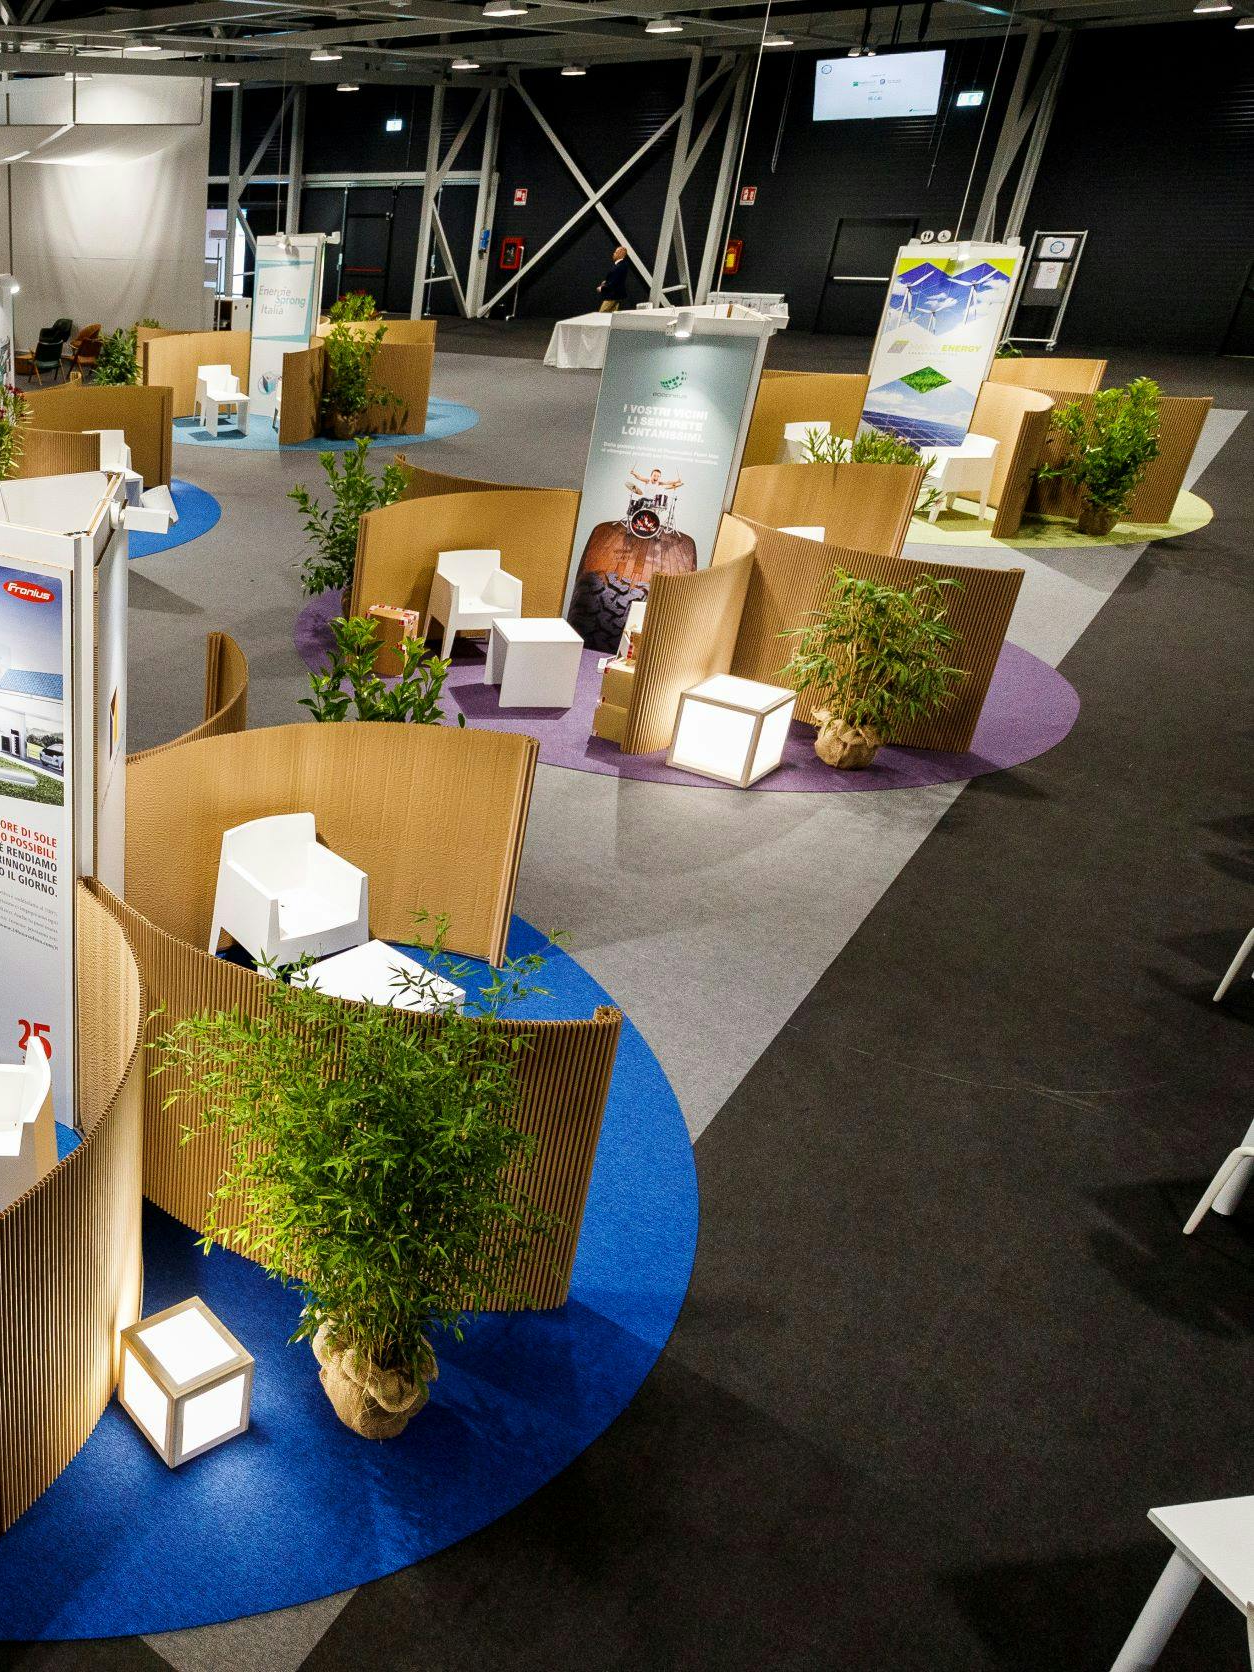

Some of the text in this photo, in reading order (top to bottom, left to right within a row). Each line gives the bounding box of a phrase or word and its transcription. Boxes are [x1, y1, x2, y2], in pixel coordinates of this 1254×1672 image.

[261, 303, 284, 315] Italia
[941, 344, 982, 352] ENERGY
[623, 403, 708, 420] I VOSTRI VICINI
[627, 415, 703, 432] LI SENTIRETE
[621, 426, 704, 443] LONTANISSIMI.
[7, 582, 51, 600] Fronius
[0, 819, 18, 834] ORE
[21, 827, 31, 838] DI
[34, 831, 57, 848] SOLE
[10, 836, 58, 860] POSSIBILI.
[7, 845, 57, 872] RENDIAMO
[8, 870, 16, 881] IL
[18, 875, 58, 898] GIORNO.
[17, 1019, 52, 1060] 25
